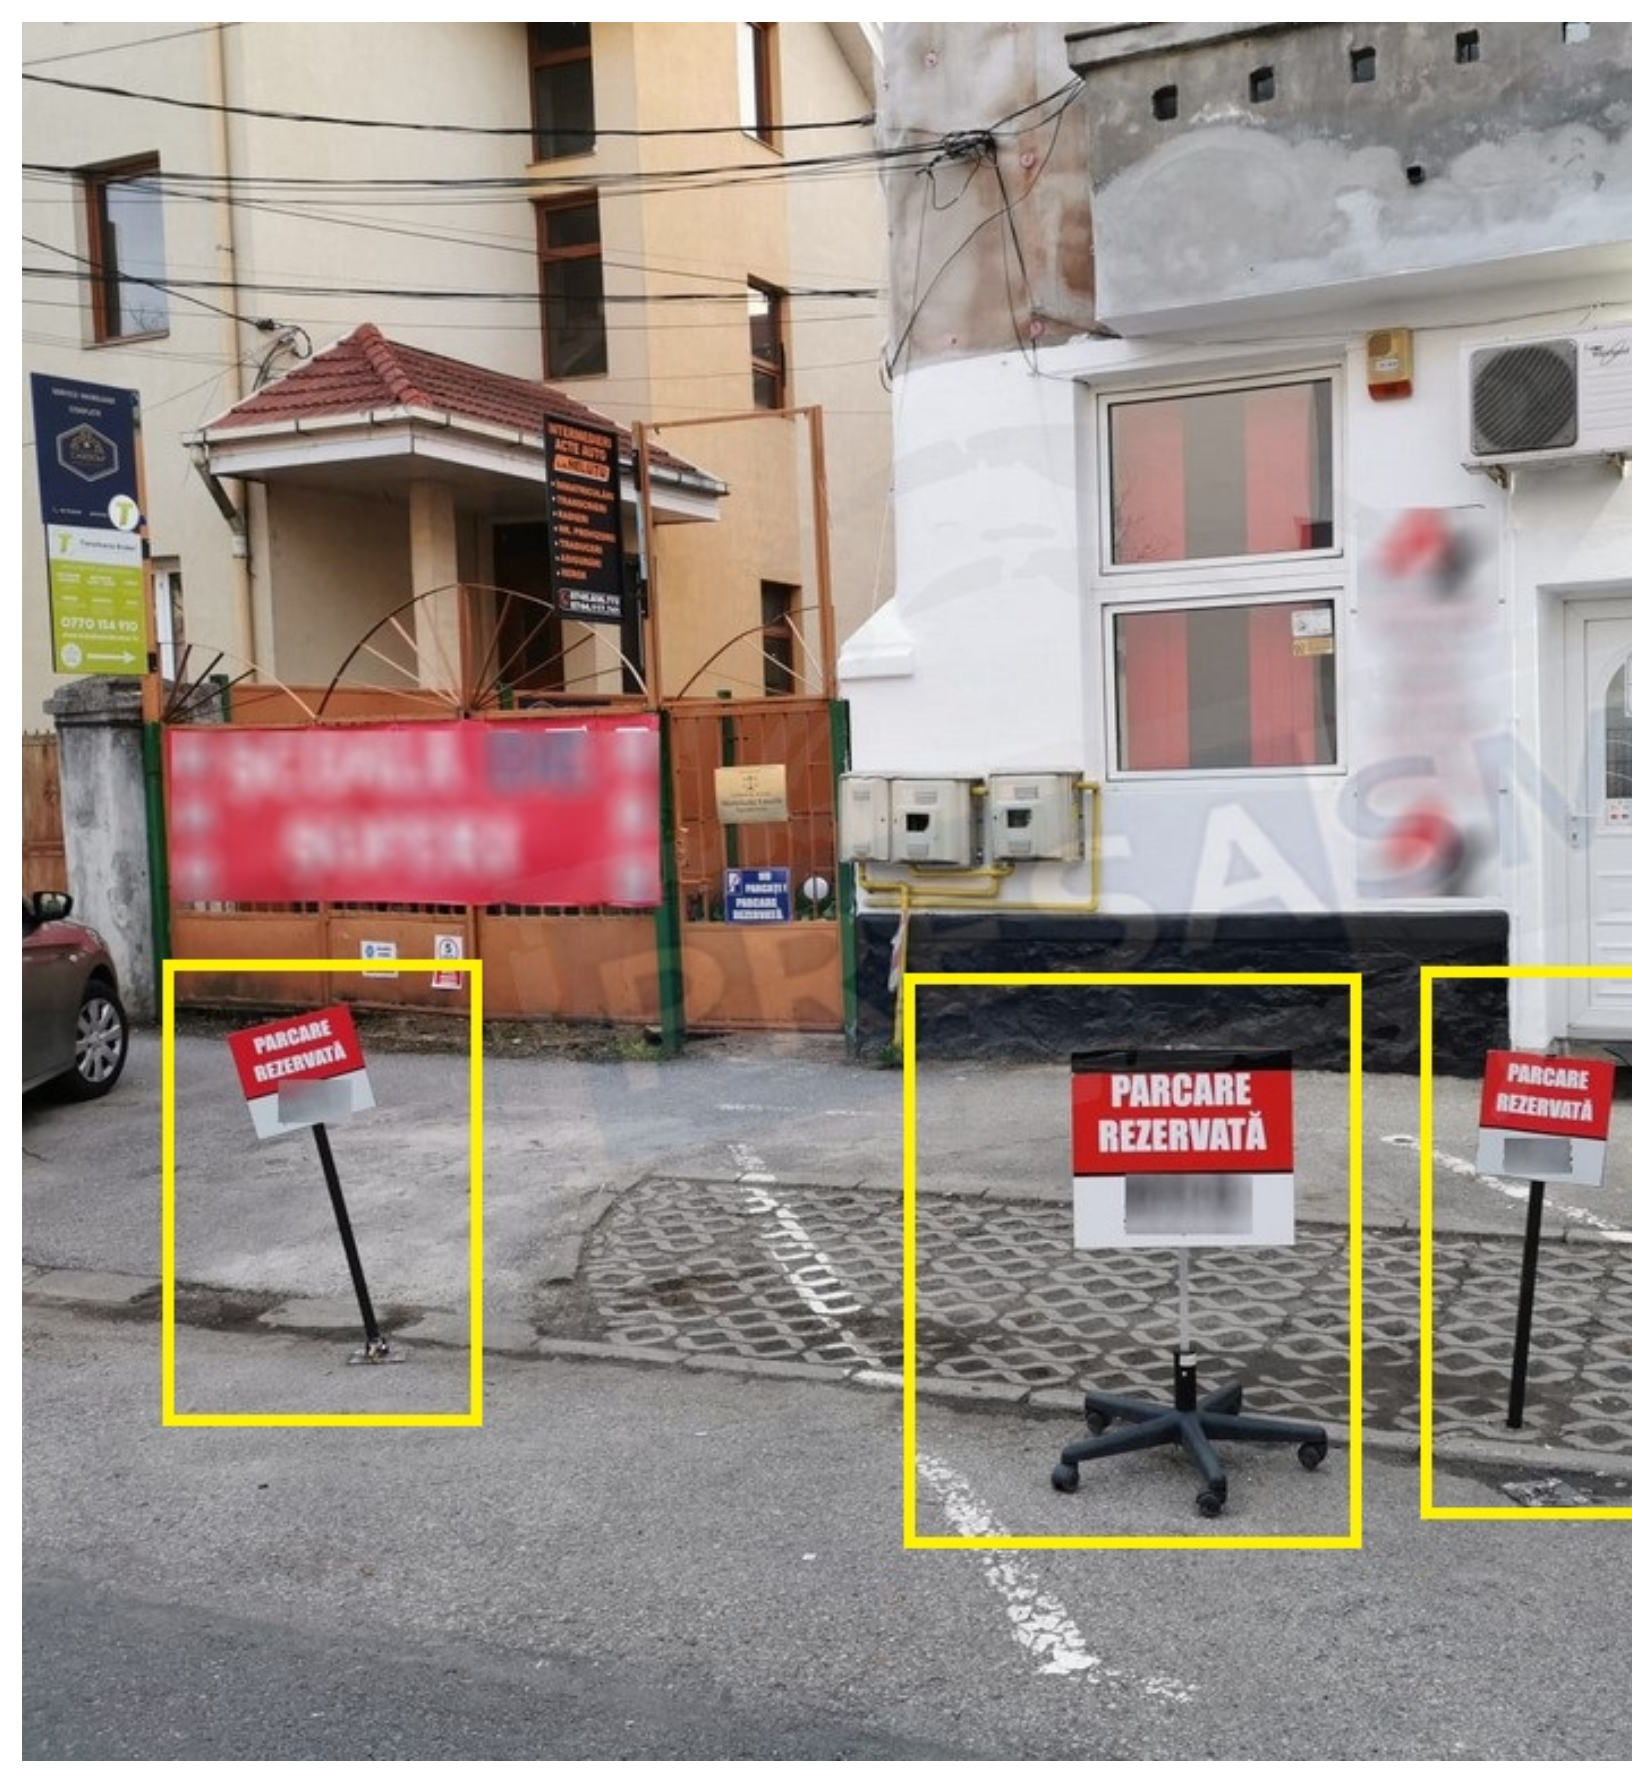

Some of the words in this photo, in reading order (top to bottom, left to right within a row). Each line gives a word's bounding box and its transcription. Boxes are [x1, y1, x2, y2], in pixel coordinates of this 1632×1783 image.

[736, 898, 778, 908] PARCARE
[252, 1018, 333, 1055] PARCARE
[252, 1039, 348, 1083] REZERVATĂ
[1507, 1062, 1590, 1090] PARCARE
[1110, 1072, 1253, 1108] PARCARE
[1495, 1092, 1594, 1122] REZERVATĂ
[1098, 1110, 1268, 1153] REZERVATĂ
